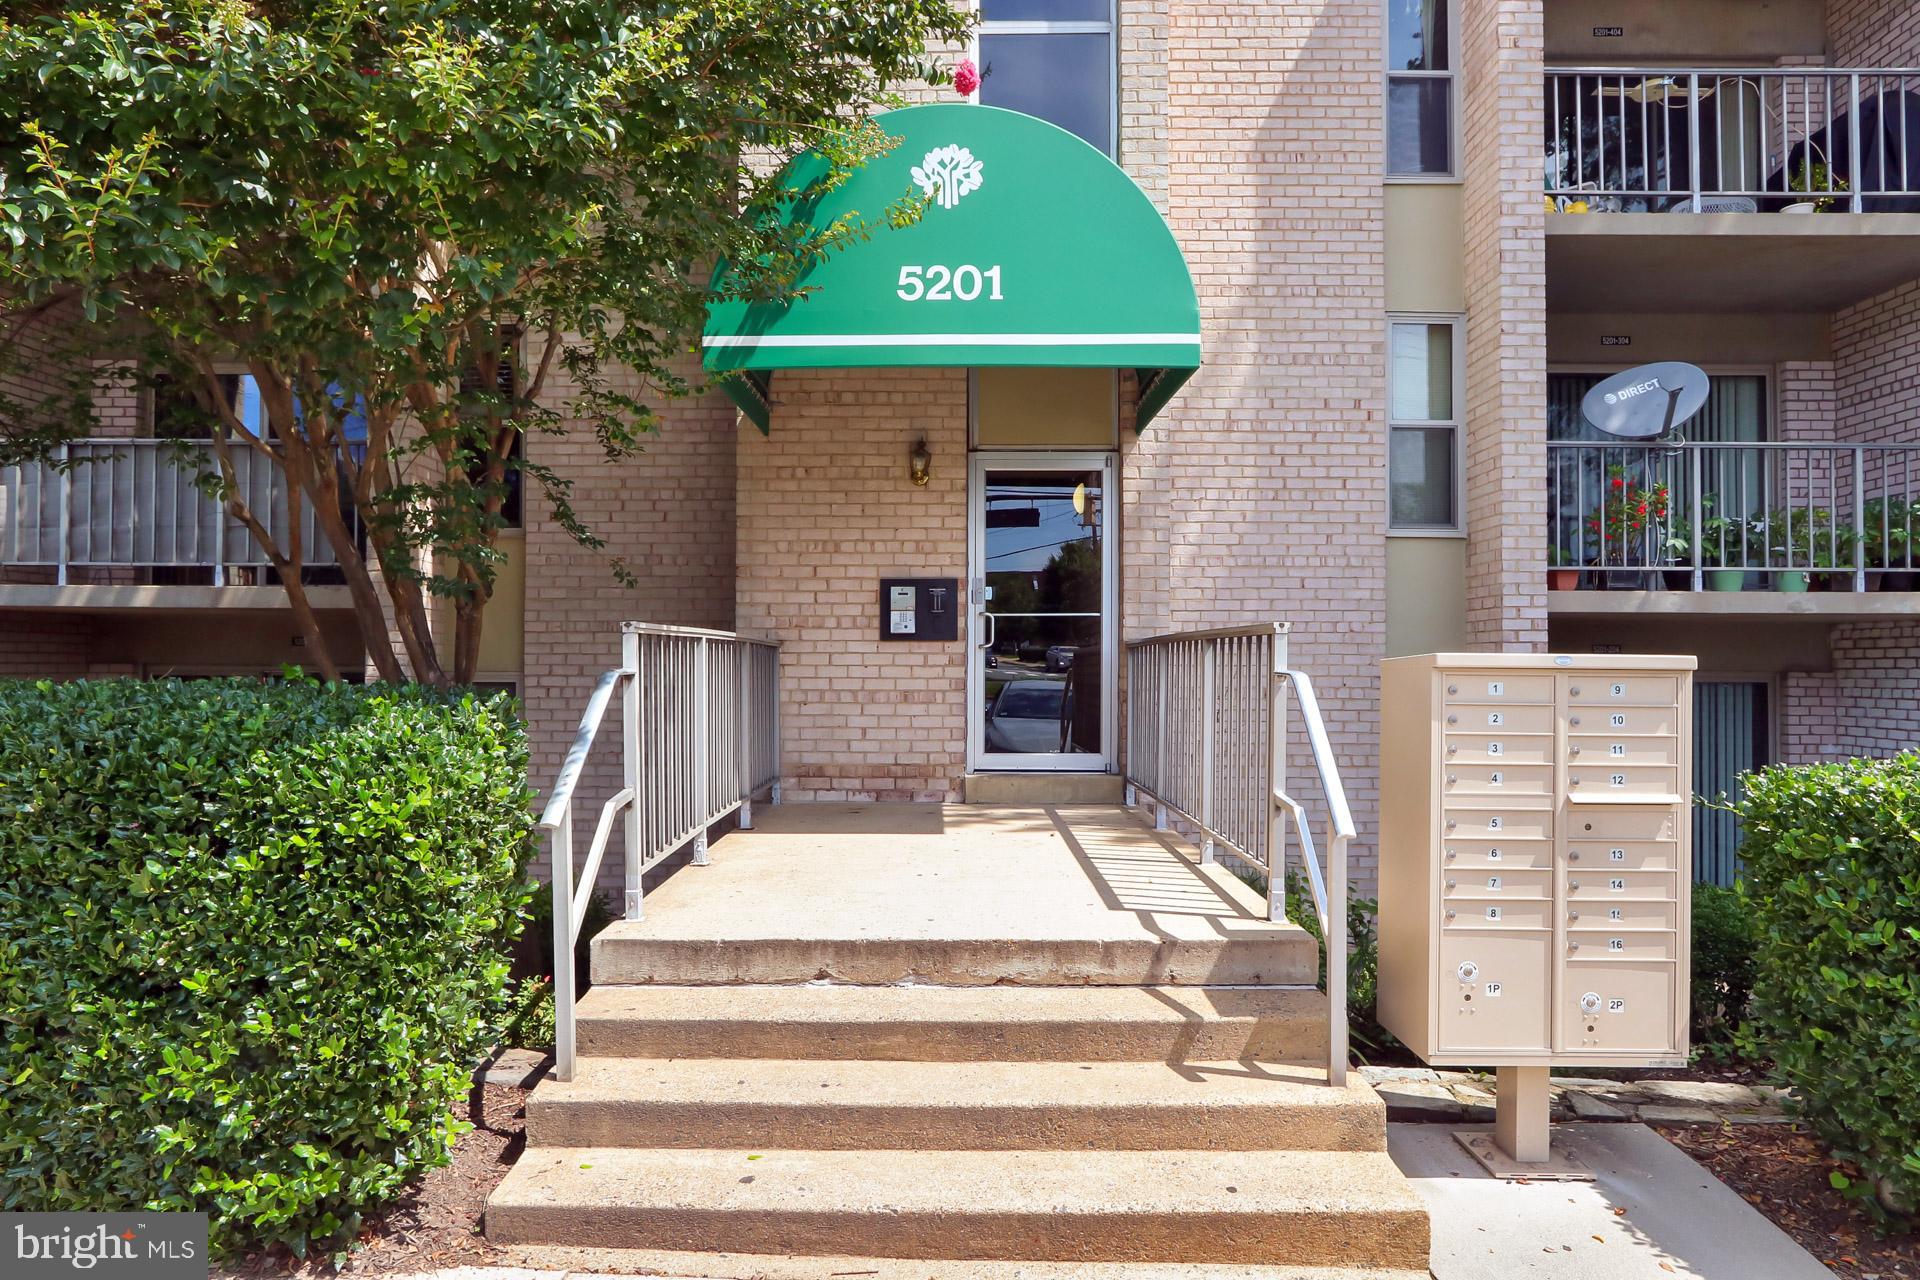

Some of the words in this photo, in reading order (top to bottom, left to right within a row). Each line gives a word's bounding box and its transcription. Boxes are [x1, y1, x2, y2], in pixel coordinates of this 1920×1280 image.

[896, 264, 1004, 301] 5201
[1493, 684, 1498, 694] 1
[1614, 685, 1621, 695] 9
[1492, 713, 1499, 723] 2
[1612, 715, 1624, 725] 10
[1492, 743, 1498, 753] 3
[1612, 745, 1623, 754] 11
[1491, 774, 1498, 783] 4
[1612, 775, 1624, 785] 12
[1491, 818, 1498, 828] 5
[1491, 848, 1498, 858] 6
[1611, 850, 1623, 860] 13
[1490, 878, 1497, 888] 7
[1611, 880, 1623, 889] 14
[1490, 908, 1497, 918] 8
[1611, 940, 1623, 949] 16
[1487, 984, 1501, 993] 1P
[1610, 1000, 1623, 1010] 2P
